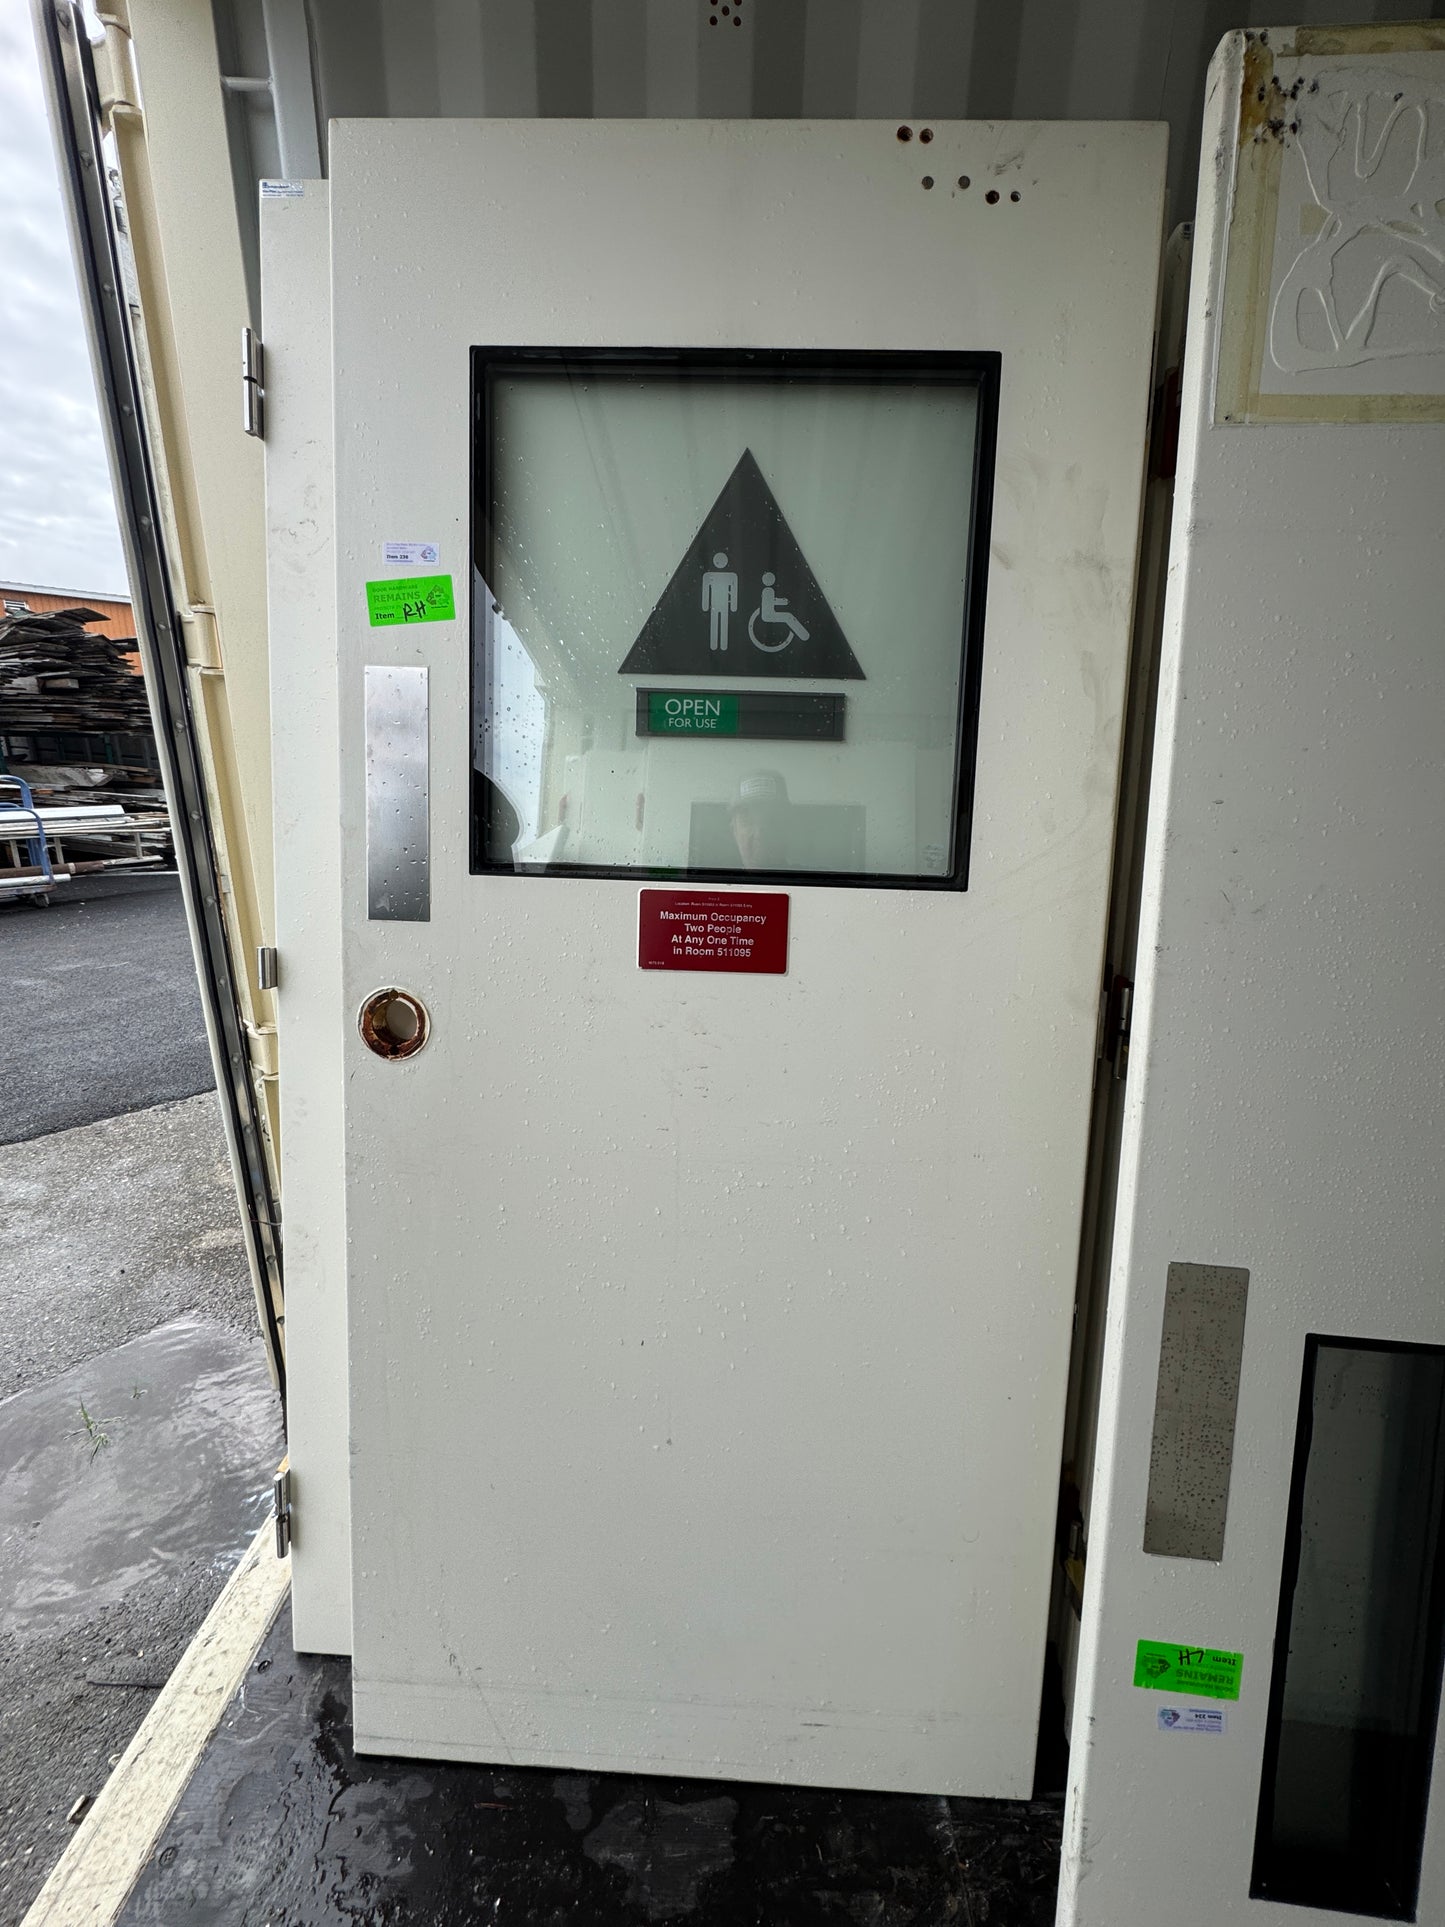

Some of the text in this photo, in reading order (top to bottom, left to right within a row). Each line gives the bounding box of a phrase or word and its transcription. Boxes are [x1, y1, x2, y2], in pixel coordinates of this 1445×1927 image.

[373, 591, 421, 603] REMAINS
[375, 612, 395, 620] Item
[402, 600, 426, 622] RH
[665, 698, 720, 716] OPEN
[668, 718, 717, 729] FOR USE
[660, 910, 767, 925] Maximum Occupancy
[684, 923, 742, 935] Two People
[671, 934, 755, 946] At Any One Time
[673, 945, 752, 958] in Room 511095
[1178, 1649, 1205, 1666] LH
[1212, 1656, 1236, 1666] Item
[1175, 1669, 1234, 1685] REMAINS
